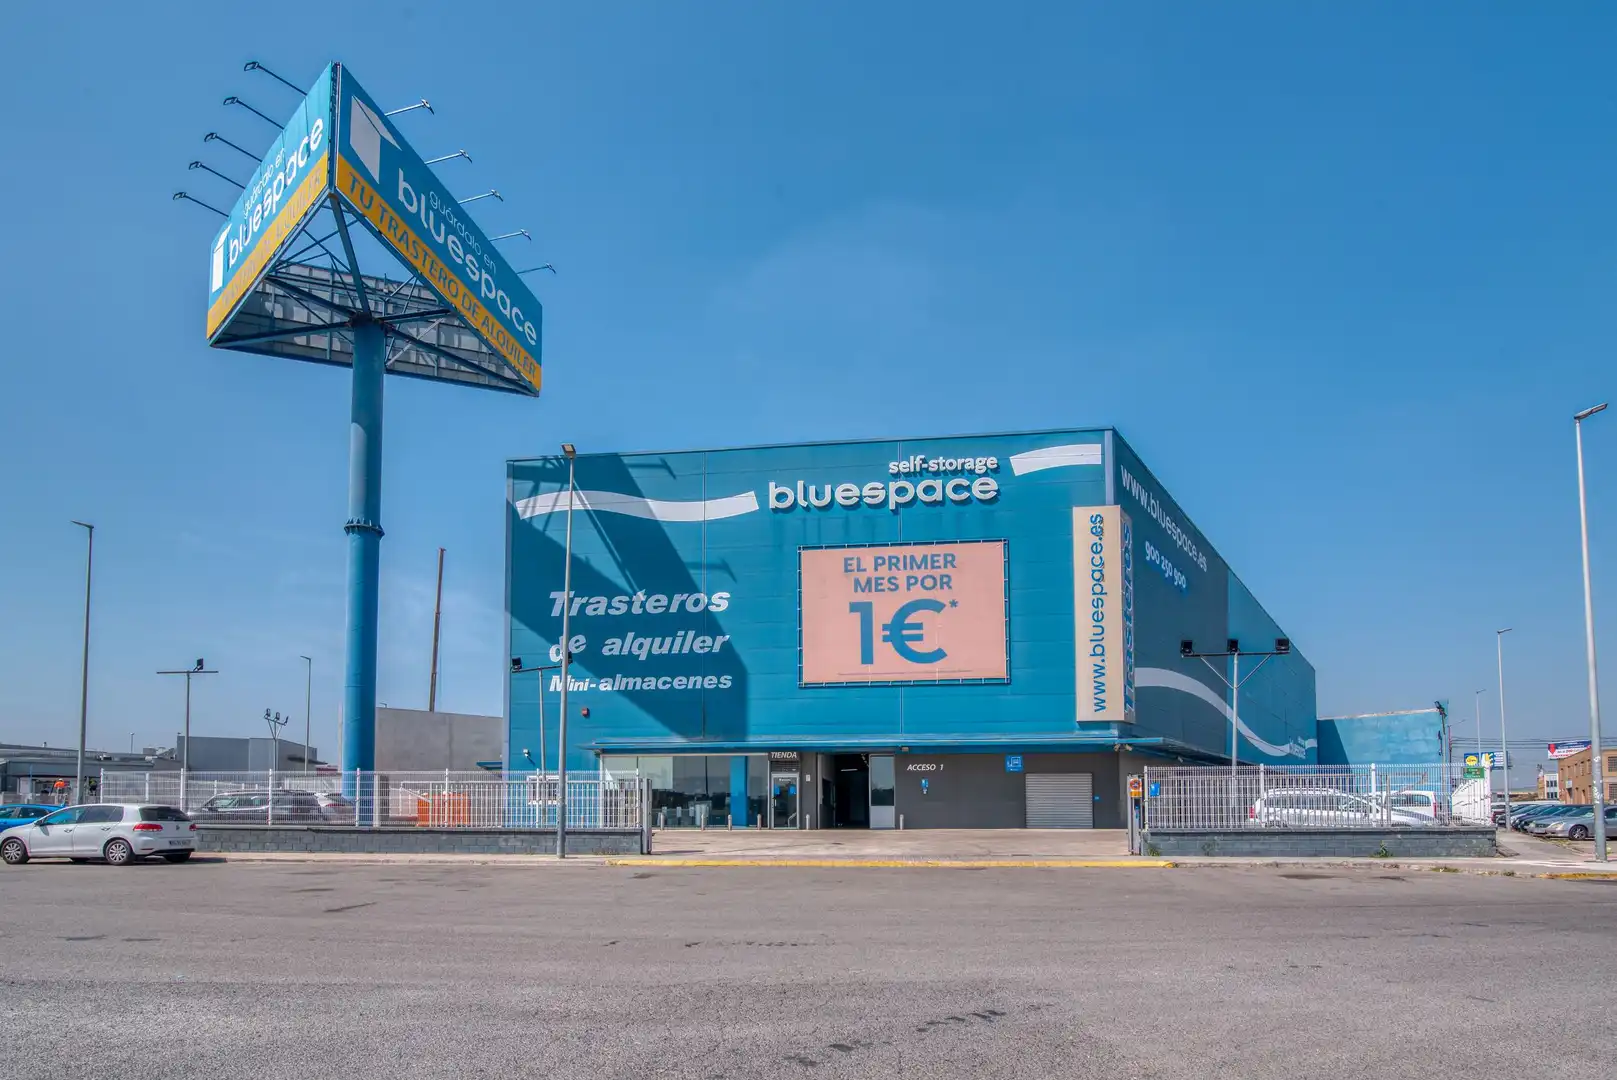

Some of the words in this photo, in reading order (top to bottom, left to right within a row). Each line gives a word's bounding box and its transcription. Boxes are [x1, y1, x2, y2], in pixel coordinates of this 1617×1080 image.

[229, 118, 323, 268] bluespace
[428, 191, 482, 256] guárdalo
[483, 252, 496, 275] en
[398, 167, 537, 346] bluespace
[349, 172, 374, 210] TU
[379, 202, 459, 298] TRASTERO
[461, 290, 480, 322] DE
[482, 314, 537, 380] ALQUILER
[889, 455, 998, 475] self-storage
[768, 477, 999, 510] bluespace
[1120, 464, 1208, 573] www.bluespace.es
[843, 557, 867, 574] EL
[873, 553, 957, 571] PRIMER
[1145, 540, 1160, 565] 900
[1160, 556, 1173, 578] 250
[1173, 568, 1187, 588] 900
[853, 576, 900, 593] MES
[906, 574, 952, 592] POR
[549, 590, 731, 616] Trasteros
[1090, 513, 1107, 713] www.bluespace.es
[602, 630, 731, 660] alquiler
[771, 751, 797, 759] TIENDA
[906, 763, 937, 771] ACCESO
[939, 763, 944, 771] 1
